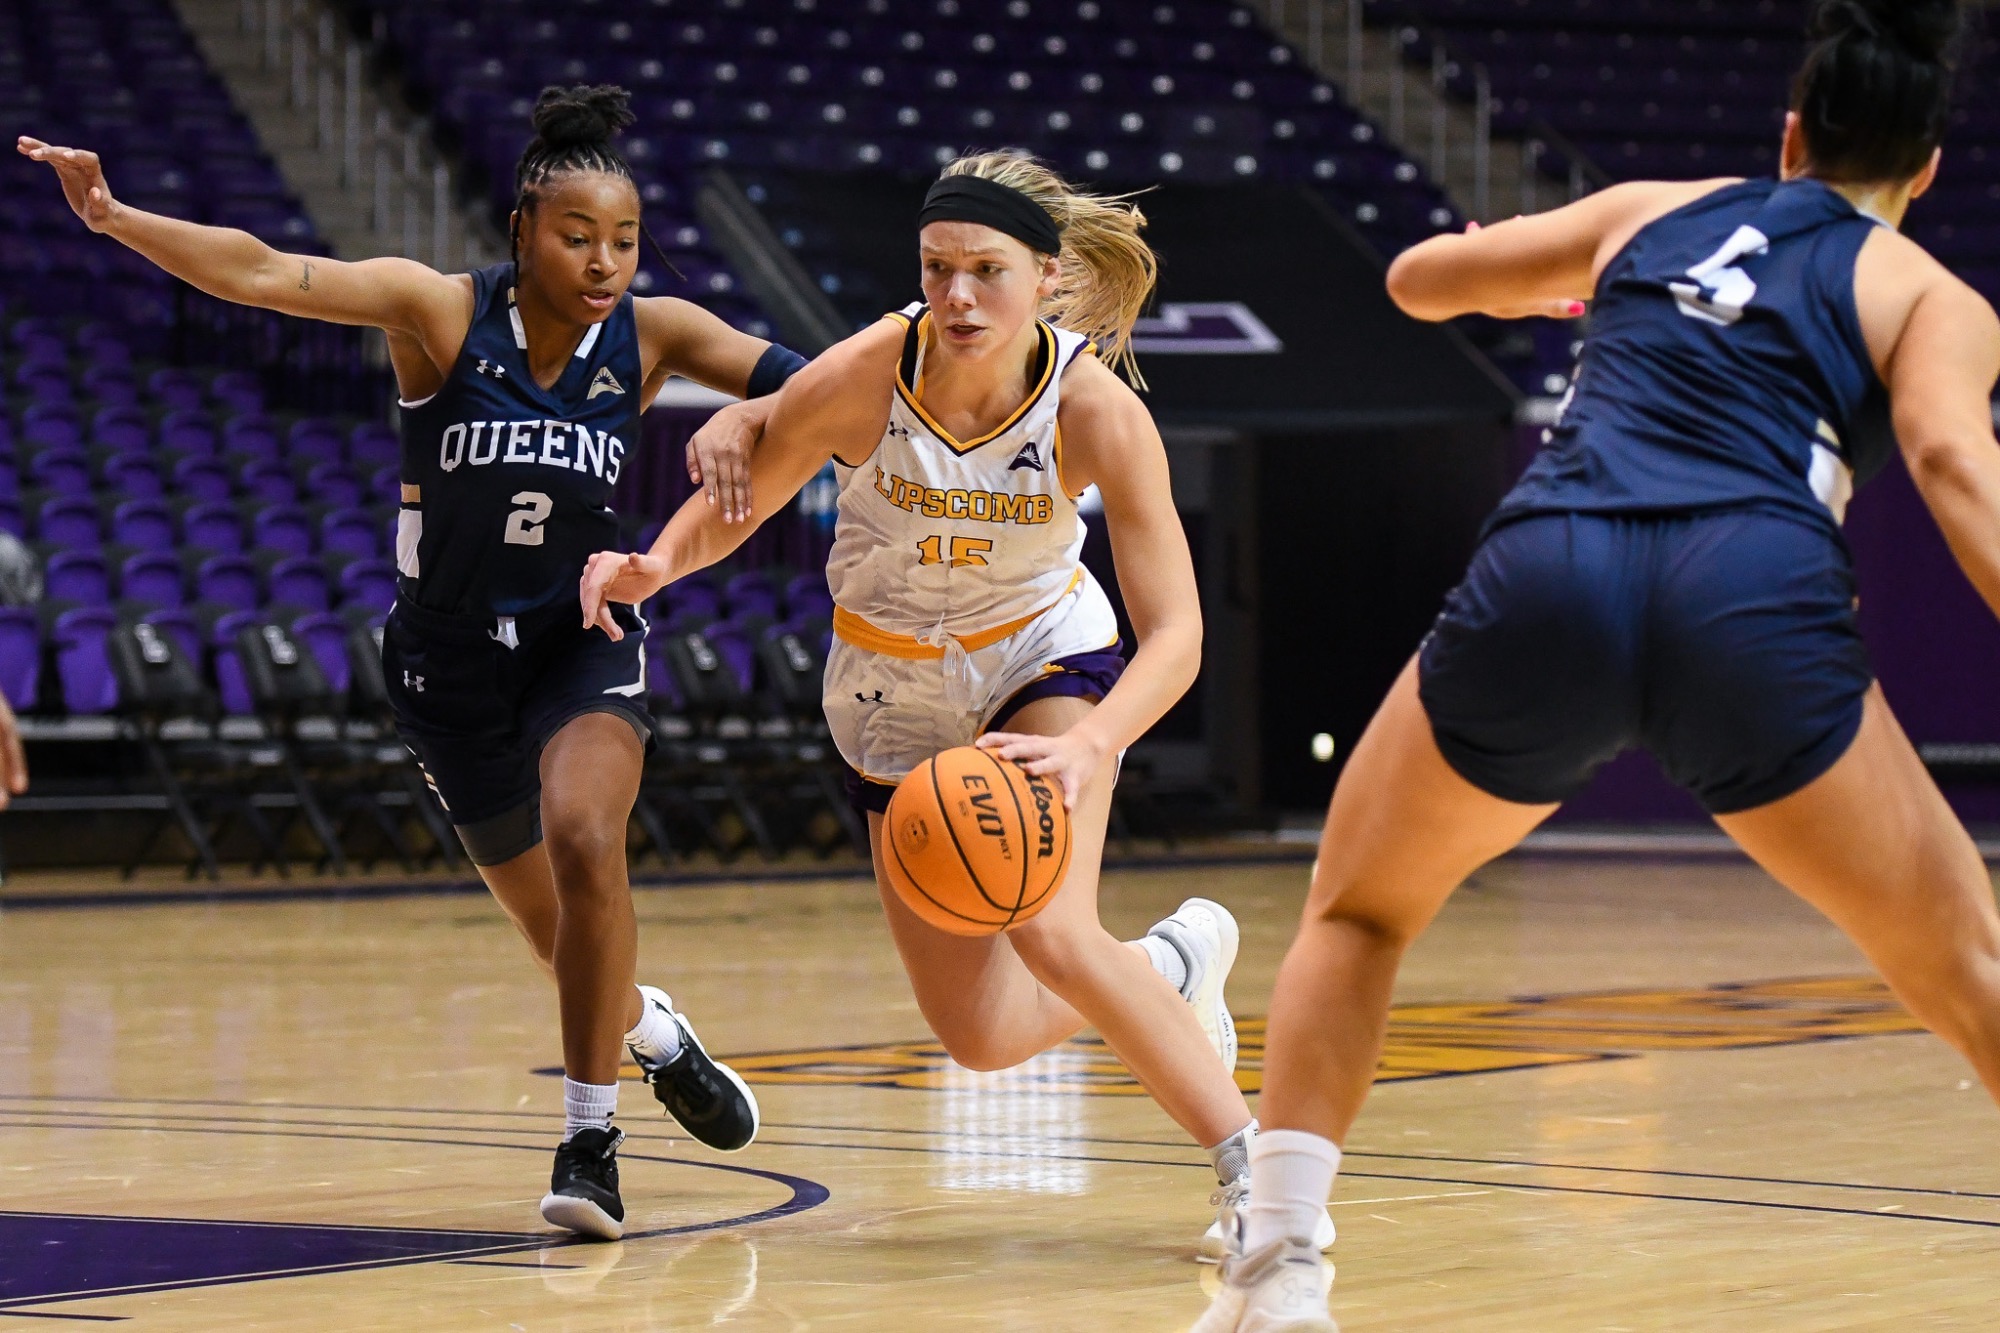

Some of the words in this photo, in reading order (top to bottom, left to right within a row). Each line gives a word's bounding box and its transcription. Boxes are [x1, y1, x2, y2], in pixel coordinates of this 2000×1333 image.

[439, 419, 625, 486] QUEENS
[504, 490, 554, 546] 2
[873, 465, 1054, 525] LIPSCOMB
[916, 535, 993, 569] 15
[961, 775, 1006, 837] EVO
